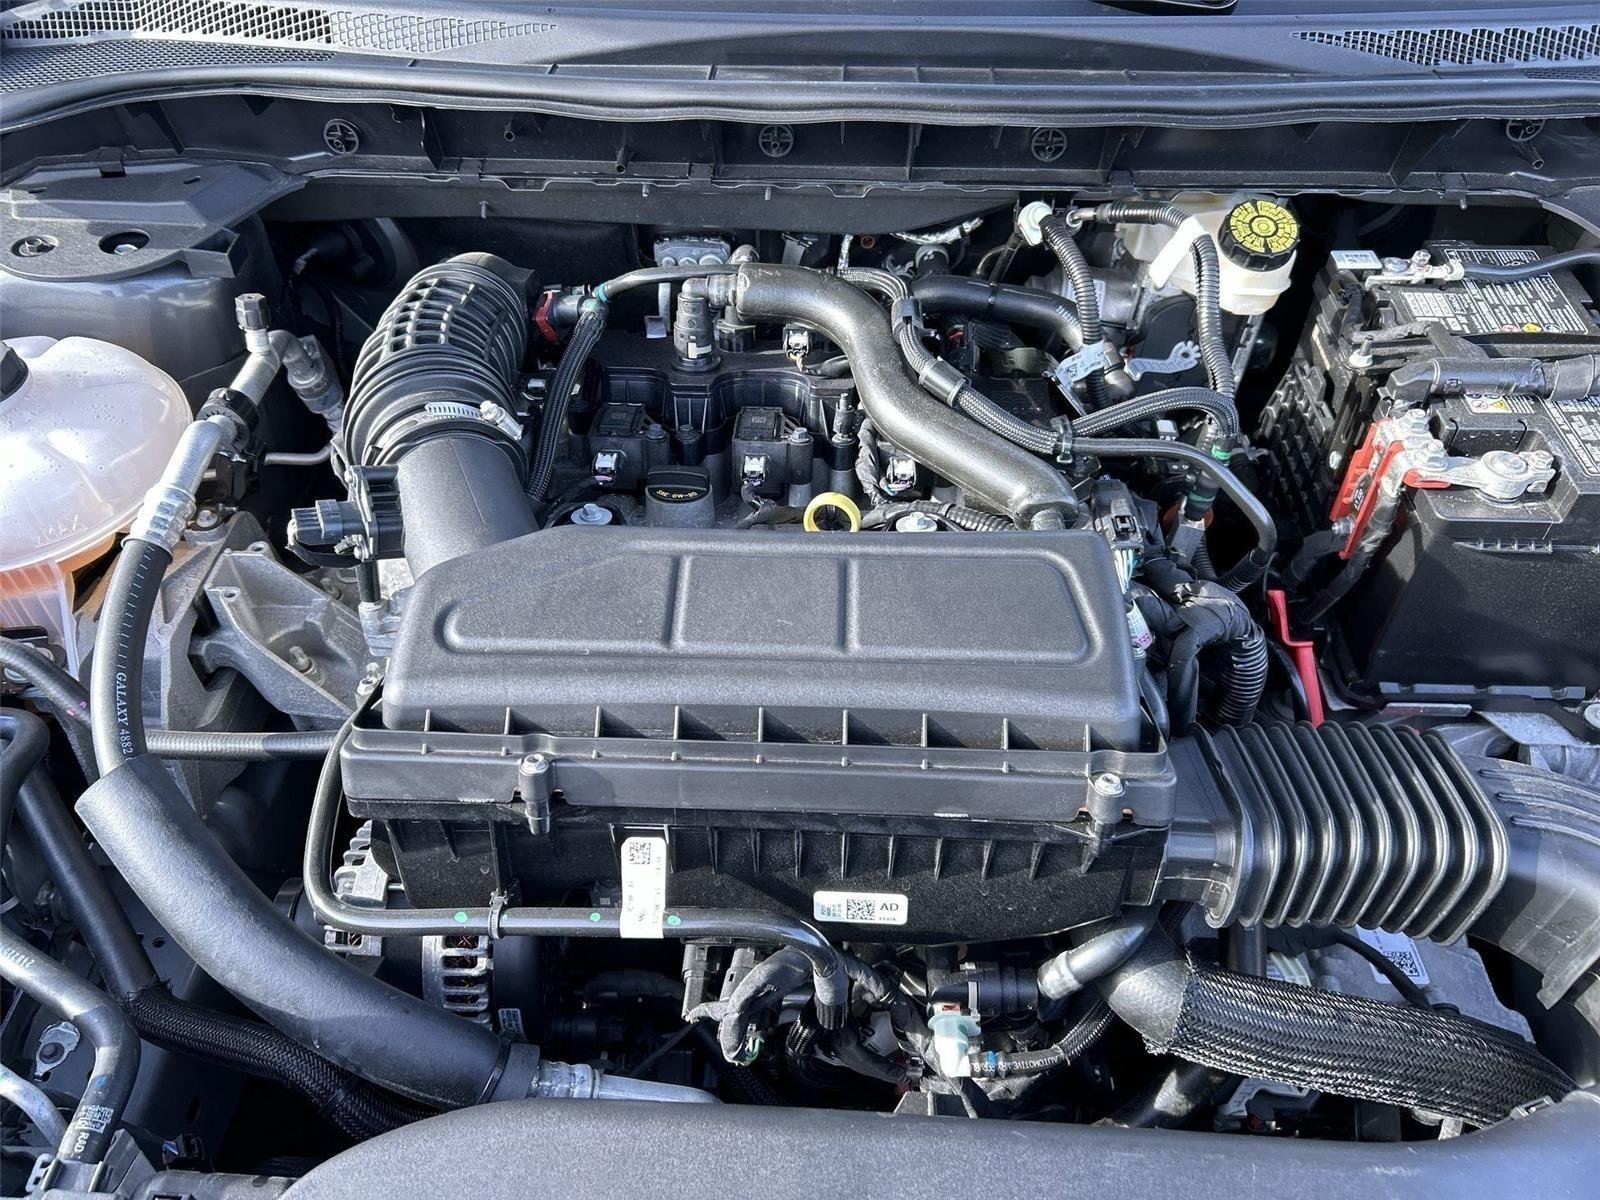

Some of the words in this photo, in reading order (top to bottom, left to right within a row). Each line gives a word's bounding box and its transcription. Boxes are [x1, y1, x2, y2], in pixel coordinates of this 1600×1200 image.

[116, 672, 129, 726] GALAXY
[120, 729, 134, 755] 4882
[879, 902, 899, 912] AD
[1012, 1055, 1059, 1071] AUTOMOTIVE
[74, 1132, 90, 1154] RAD
